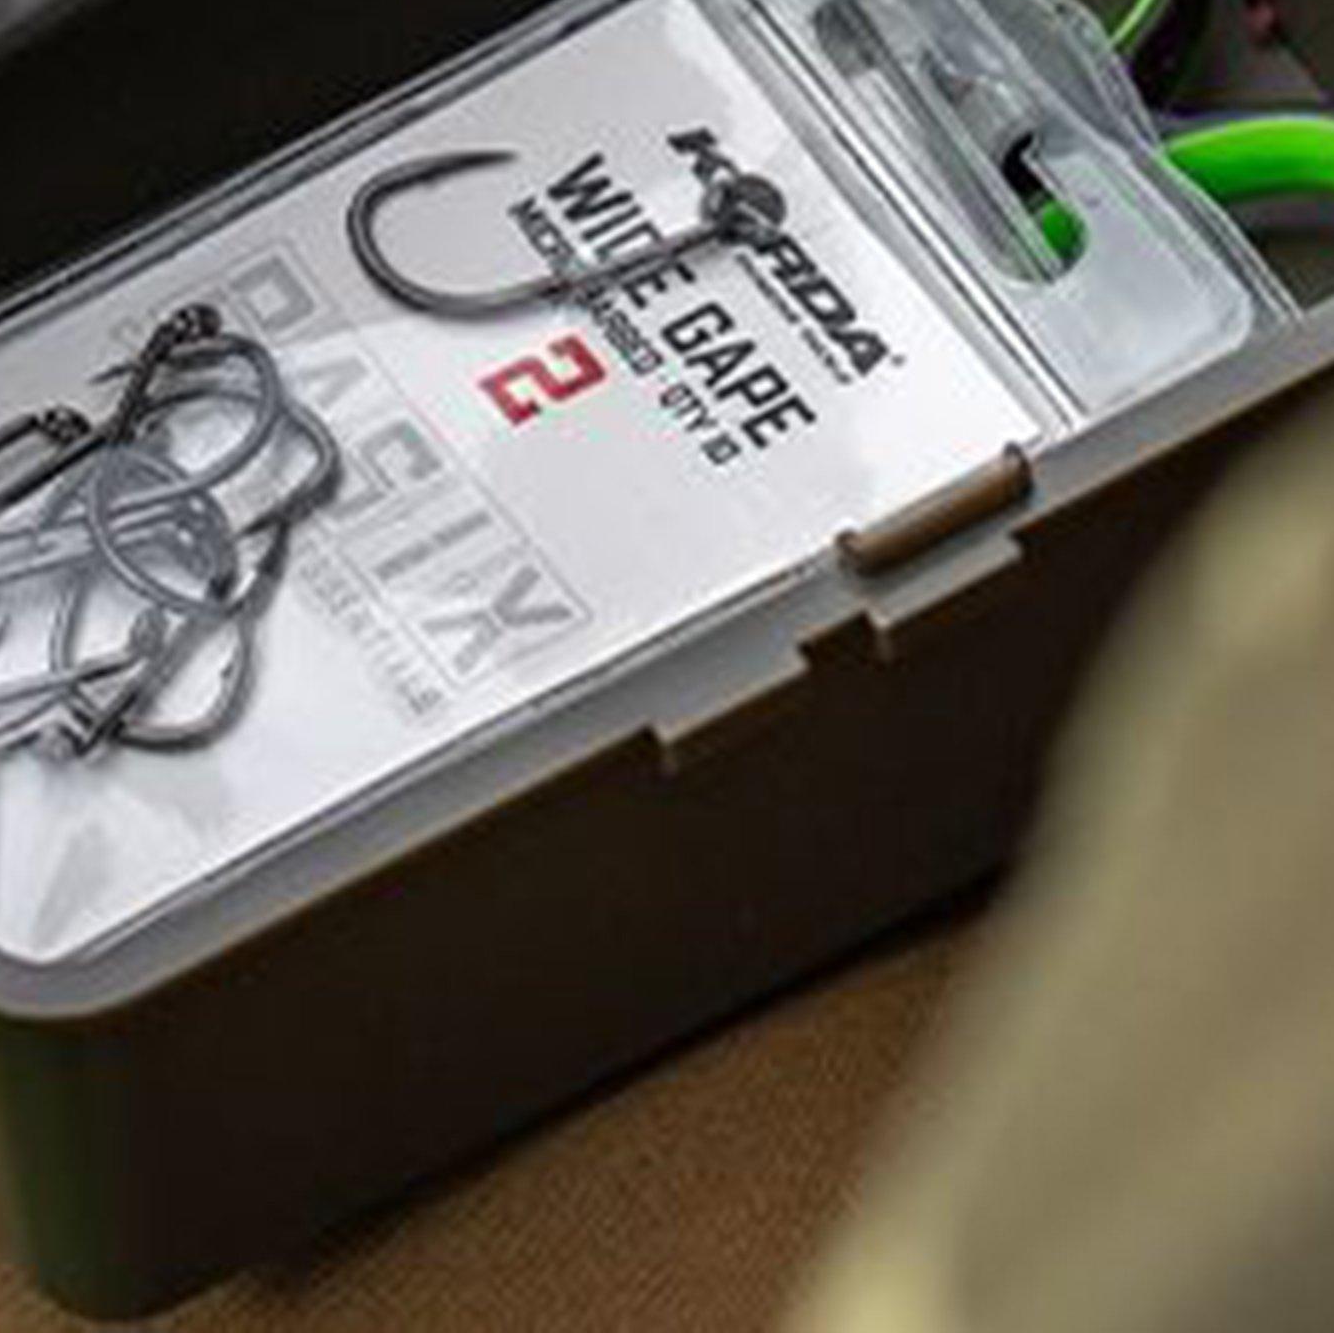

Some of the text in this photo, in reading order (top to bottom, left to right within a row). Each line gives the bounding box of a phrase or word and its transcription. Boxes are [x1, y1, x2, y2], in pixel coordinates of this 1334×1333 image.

[548, 153, 696, 310] WIDE
[662, 310, 818, 451] GAPE
[666, 126, 888, 379] KORDA
[481, 336, 609, 425] 2
